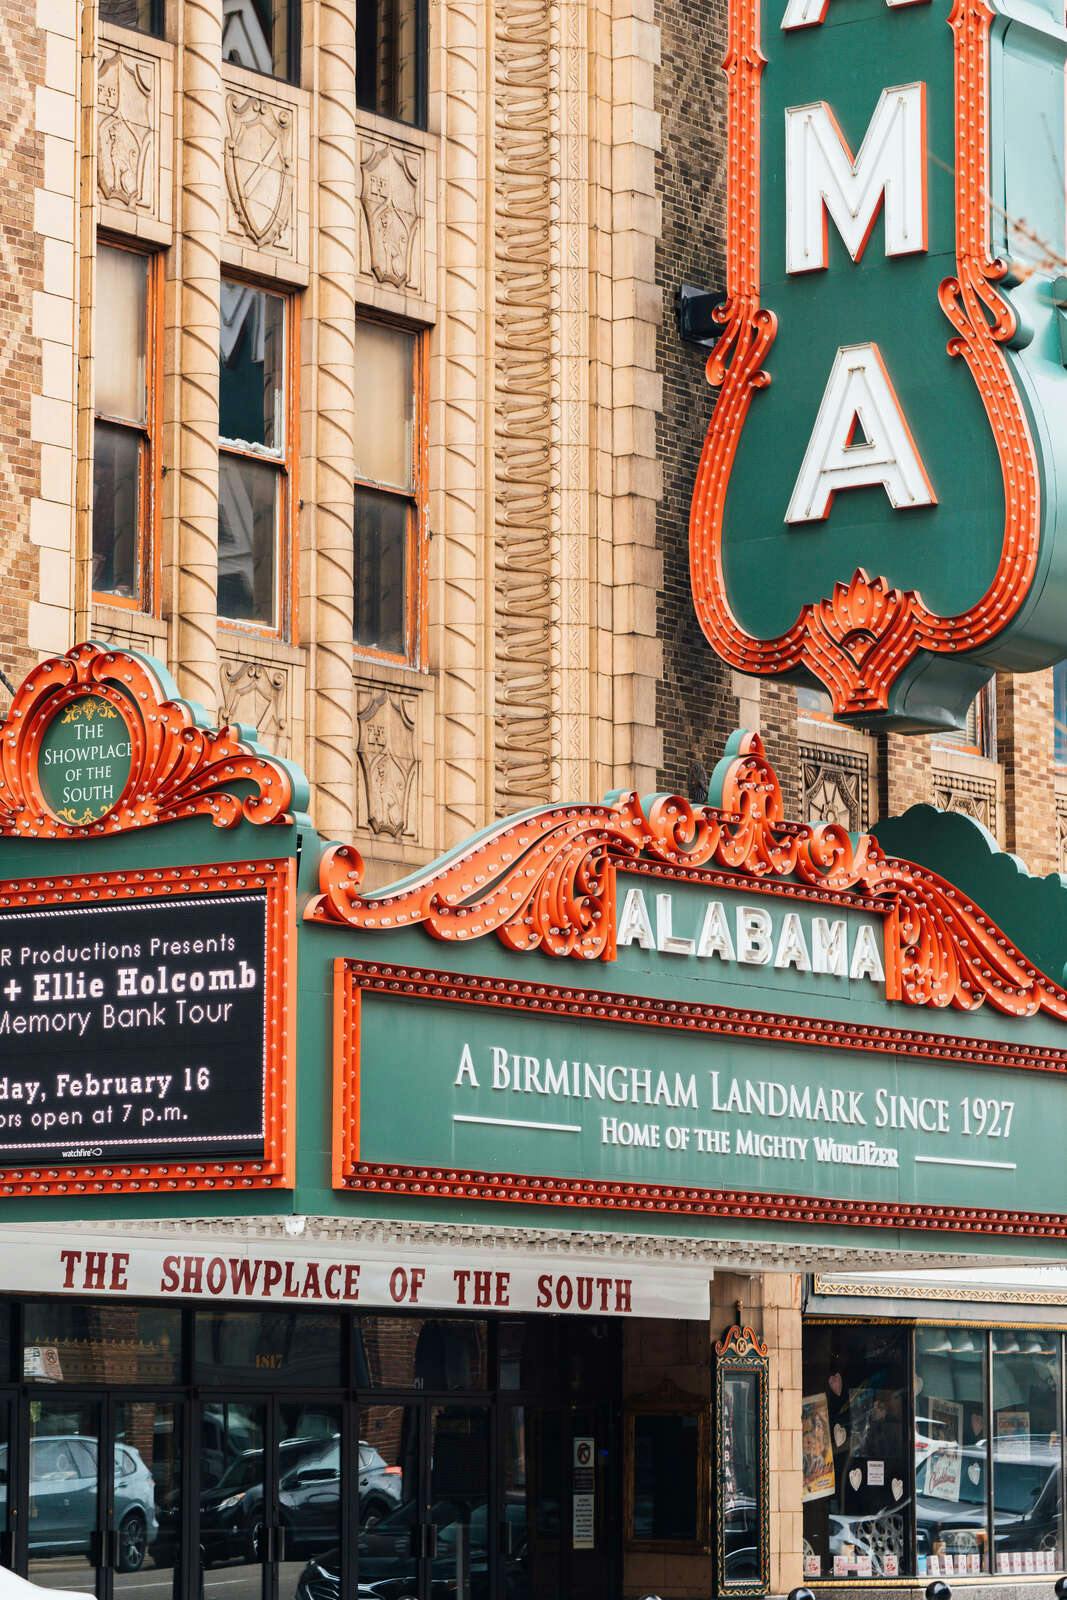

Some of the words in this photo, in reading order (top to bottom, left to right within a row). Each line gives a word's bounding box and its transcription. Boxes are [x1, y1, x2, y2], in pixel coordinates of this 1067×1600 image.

[781, 0, 938, 524] MA
[74, 724, 104, 740] THE
[44, 742, 133, 765] SHOWPLACE
[65, 768, 82, 782] OF
[86, 765, 112, 780] THE
[62, 784, 113, 803] SOUTH
[20, 942, 141, 965] Productions
[150, 933, 235, 957] Presents
[616, 887, 886, 983] ALABAMA
[33, 971, 104, 1001] Ellie
[117, 960, 256, 997] Holcomb
[103, 1001, 166, 1029] Bank
[176, 999, 233, 1024] Tour
[56, 1073, 173, 1099] February
[184, 1067, 211, 1092] 16
[453, 1042, 480, 1088] A
[490, 1046, 699, 1109] BIRMINGHAM
[710, 1069, 866, 1125] LANDMARK
[874, 1087, 951, 1132] SINCE
[960, 1096, 1016, 1138] 1927
[31, 1111, 83, 1131] open
[92, 1105, 113, 1124] at
[122, 1103, 133, 1123] 7
[142, 1106, 189, 1127] p.m.
[600, 1116, 661, 1148] HOME
[665, 1126, 691, 1150] OF
[693, 1129, 731, 1154] THE
[735, 1129, 810, 1161] MIGHTY
[60, 1249, 131, 1291] THE
[160, 1254, 361, 1302] SHOWPLACE
[389, 1265, 427, 1304] OF
[453, 1269, 511, 1307] THE
[536, 1274, 633, 1313] SOUTH
